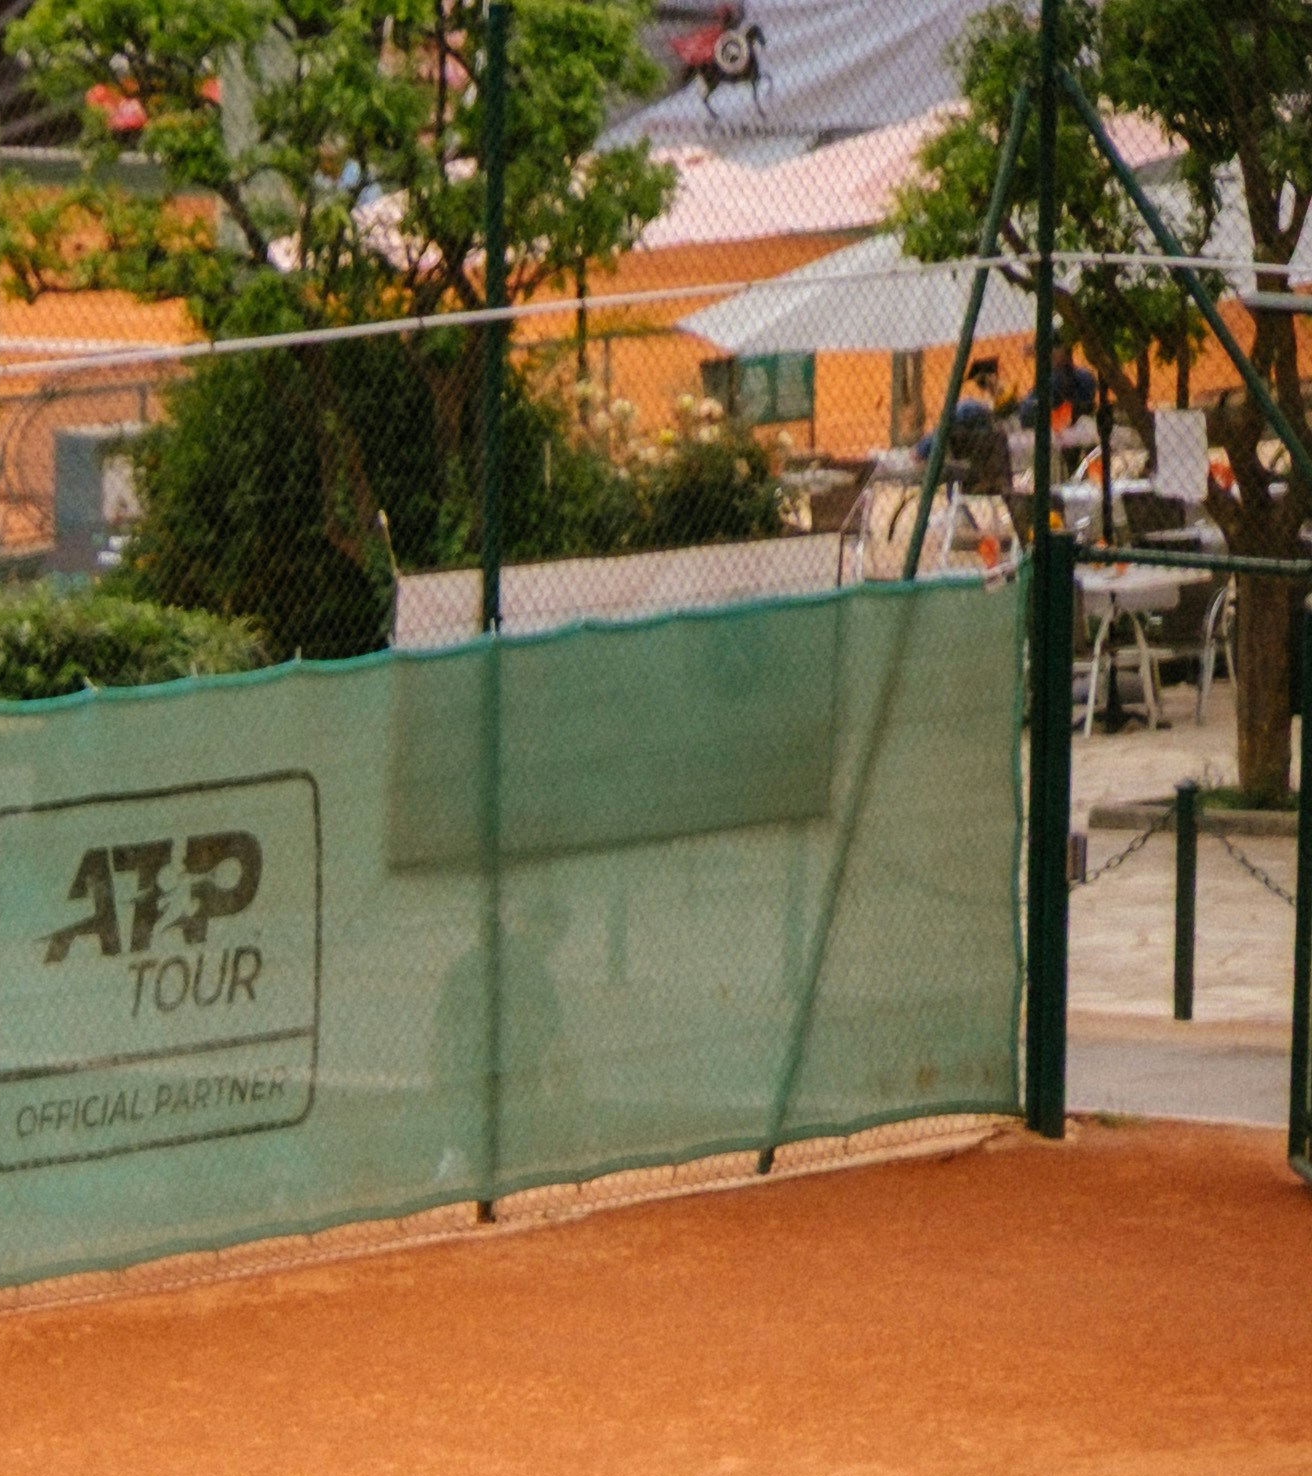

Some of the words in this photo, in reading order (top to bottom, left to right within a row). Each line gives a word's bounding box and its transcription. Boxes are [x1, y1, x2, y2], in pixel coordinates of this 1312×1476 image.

[33, 829, 264, 964] ATP
[128, 944, 264, 1018] TOUR
[15, 1090, 144, 1139] OFFICIAL
[153, 1065, 287, 1117] PARTNER
